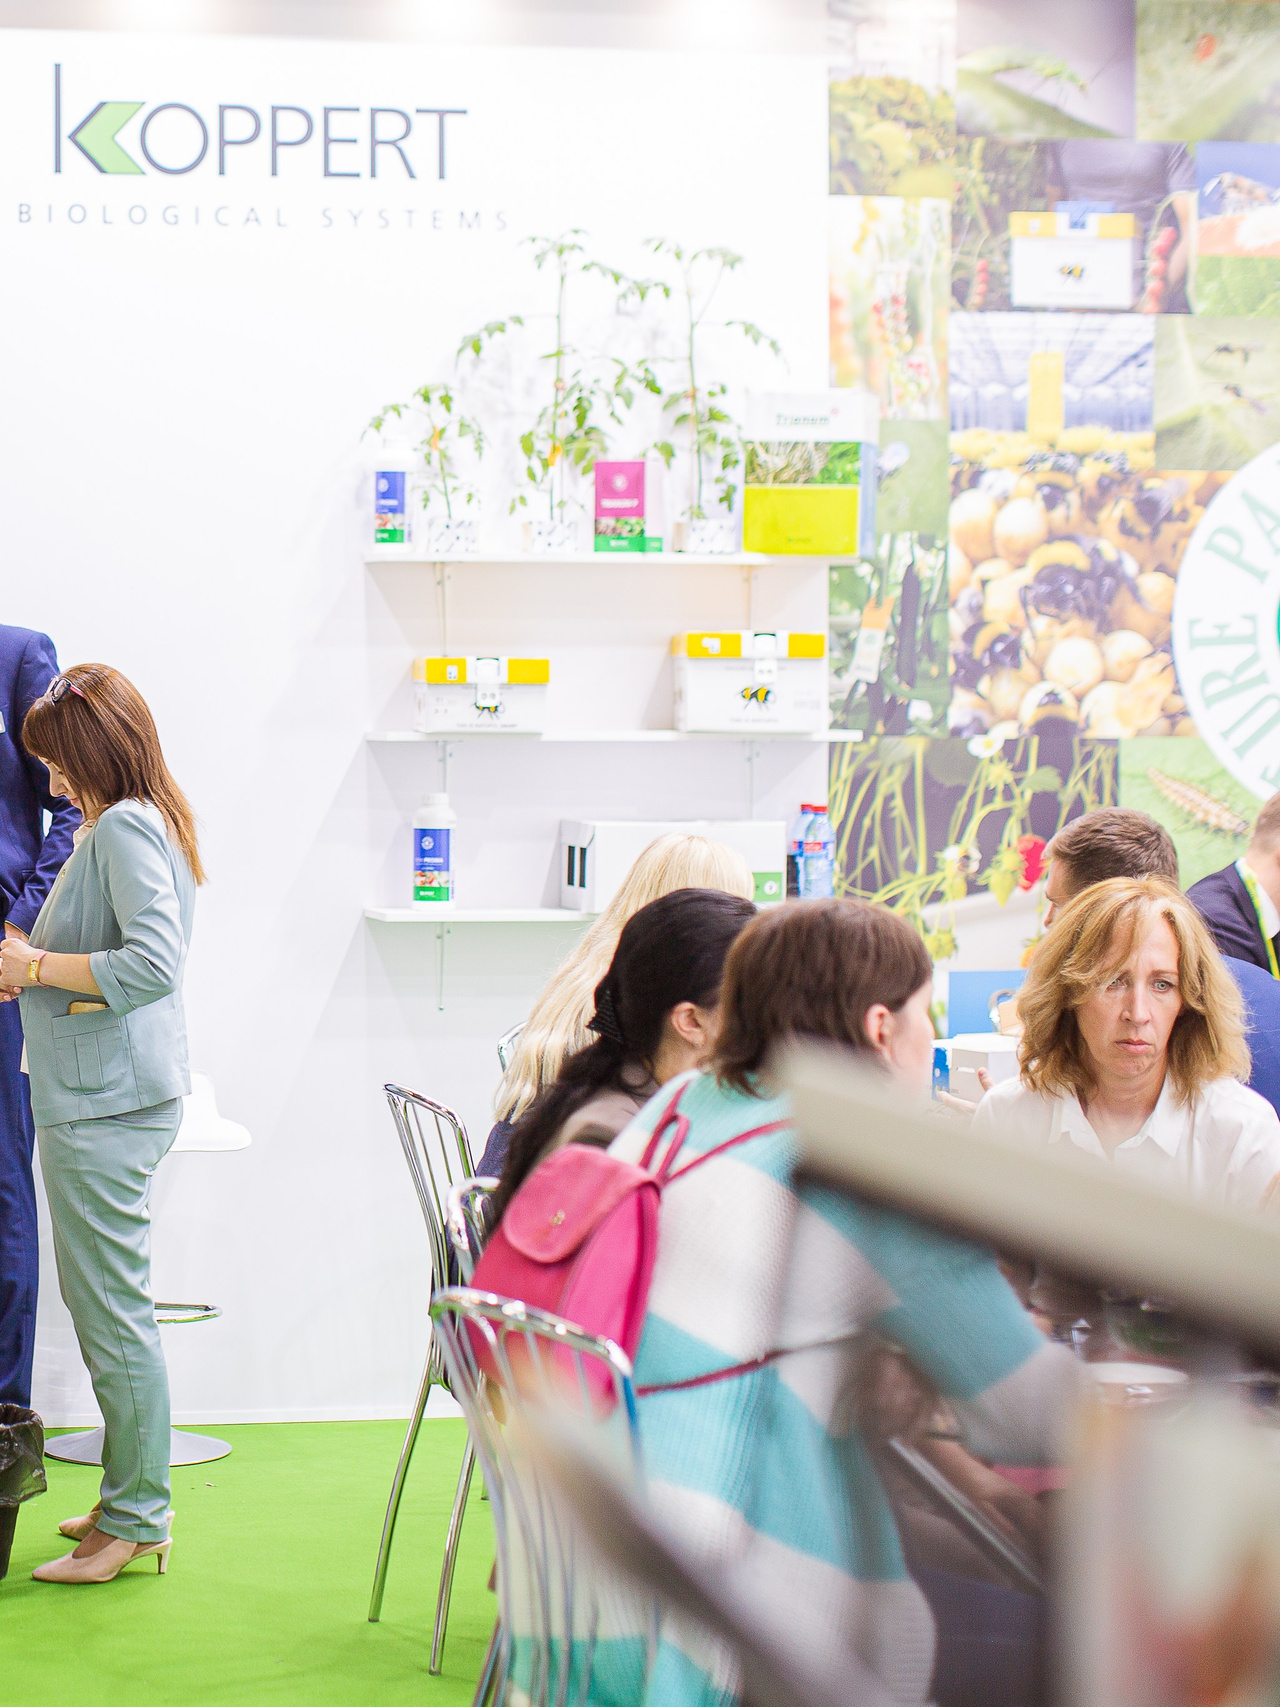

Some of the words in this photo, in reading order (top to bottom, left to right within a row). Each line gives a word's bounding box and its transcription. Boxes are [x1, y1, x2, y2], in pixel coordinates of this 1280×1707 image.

[53, 62, 469, 181] KOPPERT
[18, 203, 288, 227] BIOLOGICAL
[322, 208, 509, 231] SYSTEMS
